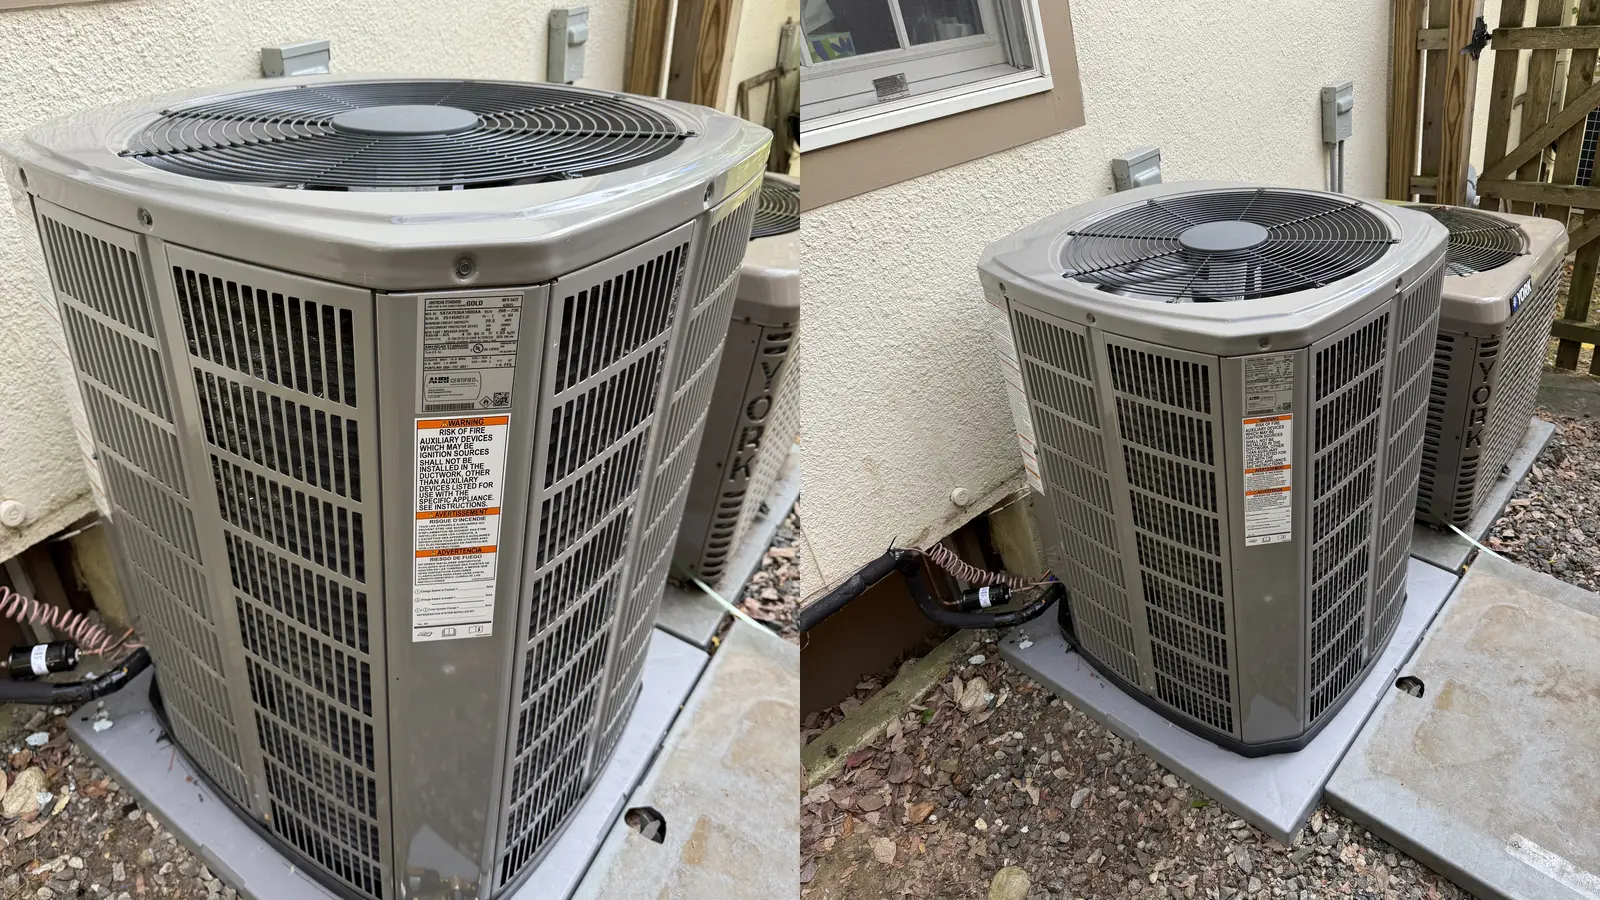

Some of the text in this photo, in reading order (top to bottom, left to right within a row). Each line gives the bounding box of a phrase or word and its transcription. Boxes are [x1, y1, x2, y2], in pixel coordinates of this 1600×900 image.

[1517, 278, 1531, 305] YORK
[1465, 360, 1496, 449] YORK
[449, 418, 484, 426] WARNING
[730, 360, 784, 482] YORK
[420, 434, 492, 444] AUXILIARY DEVICES
[440, 476, 478, 484] AUXILIARY
[419, 494, 494, 505] SPECIFIC APPLIANCE.
[434, 501, 488, 510] INSTRUCTIONS.
[435, 509, 488, 518] AVERTISSEMENT
[437, 547, 482, 556] ADVERTENCIA
